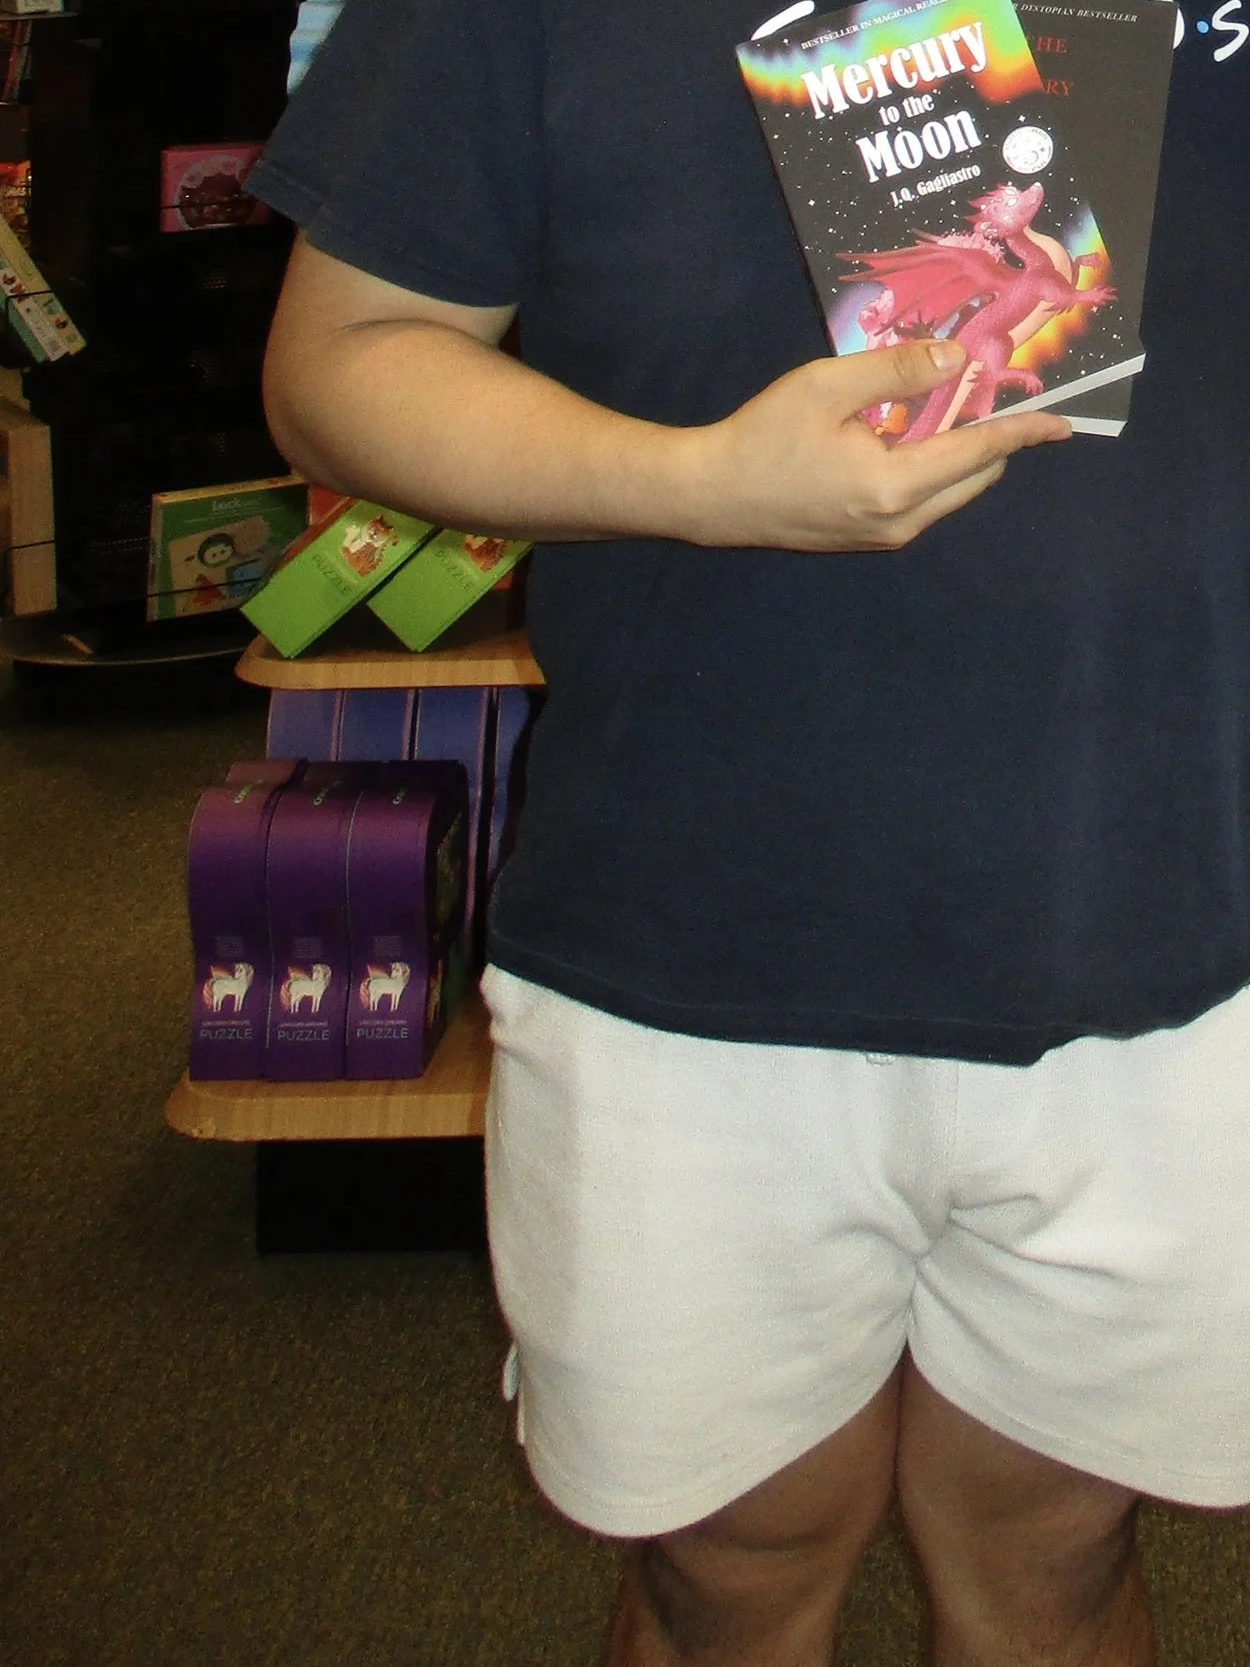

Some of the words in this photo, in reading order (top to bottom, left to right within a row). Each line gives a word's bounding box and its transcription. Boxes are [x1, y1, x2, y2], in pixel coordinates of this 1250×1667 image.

[1021, 3, 1076, 16] DYSTOPIAN
[1077, 8, 1138, 23] BESTSELLER
[801, 24, 860, 50] BESTSELLER
[860, 20, 873, 30] IN
[872, 4, 916, 27] MAGICAL
[1032, 35, 1069, 55] HE
[800, 21, 988, 120] Mercury
[1044, 80, 1075, 97] RY
[879, 104, 900, 126] to
[901, 92, 935, 118] the
[855, 109, 982, 183] Moon
[889, 184, 916, 207] J.Q.
[917, 163, 981, 198] Gagliastro
[200, 1028, 253, 1039] PUZZLE
[278, 1029, 330, 1040] PUZZLE
[356, 1028, 409, 1039] PUZZLE
